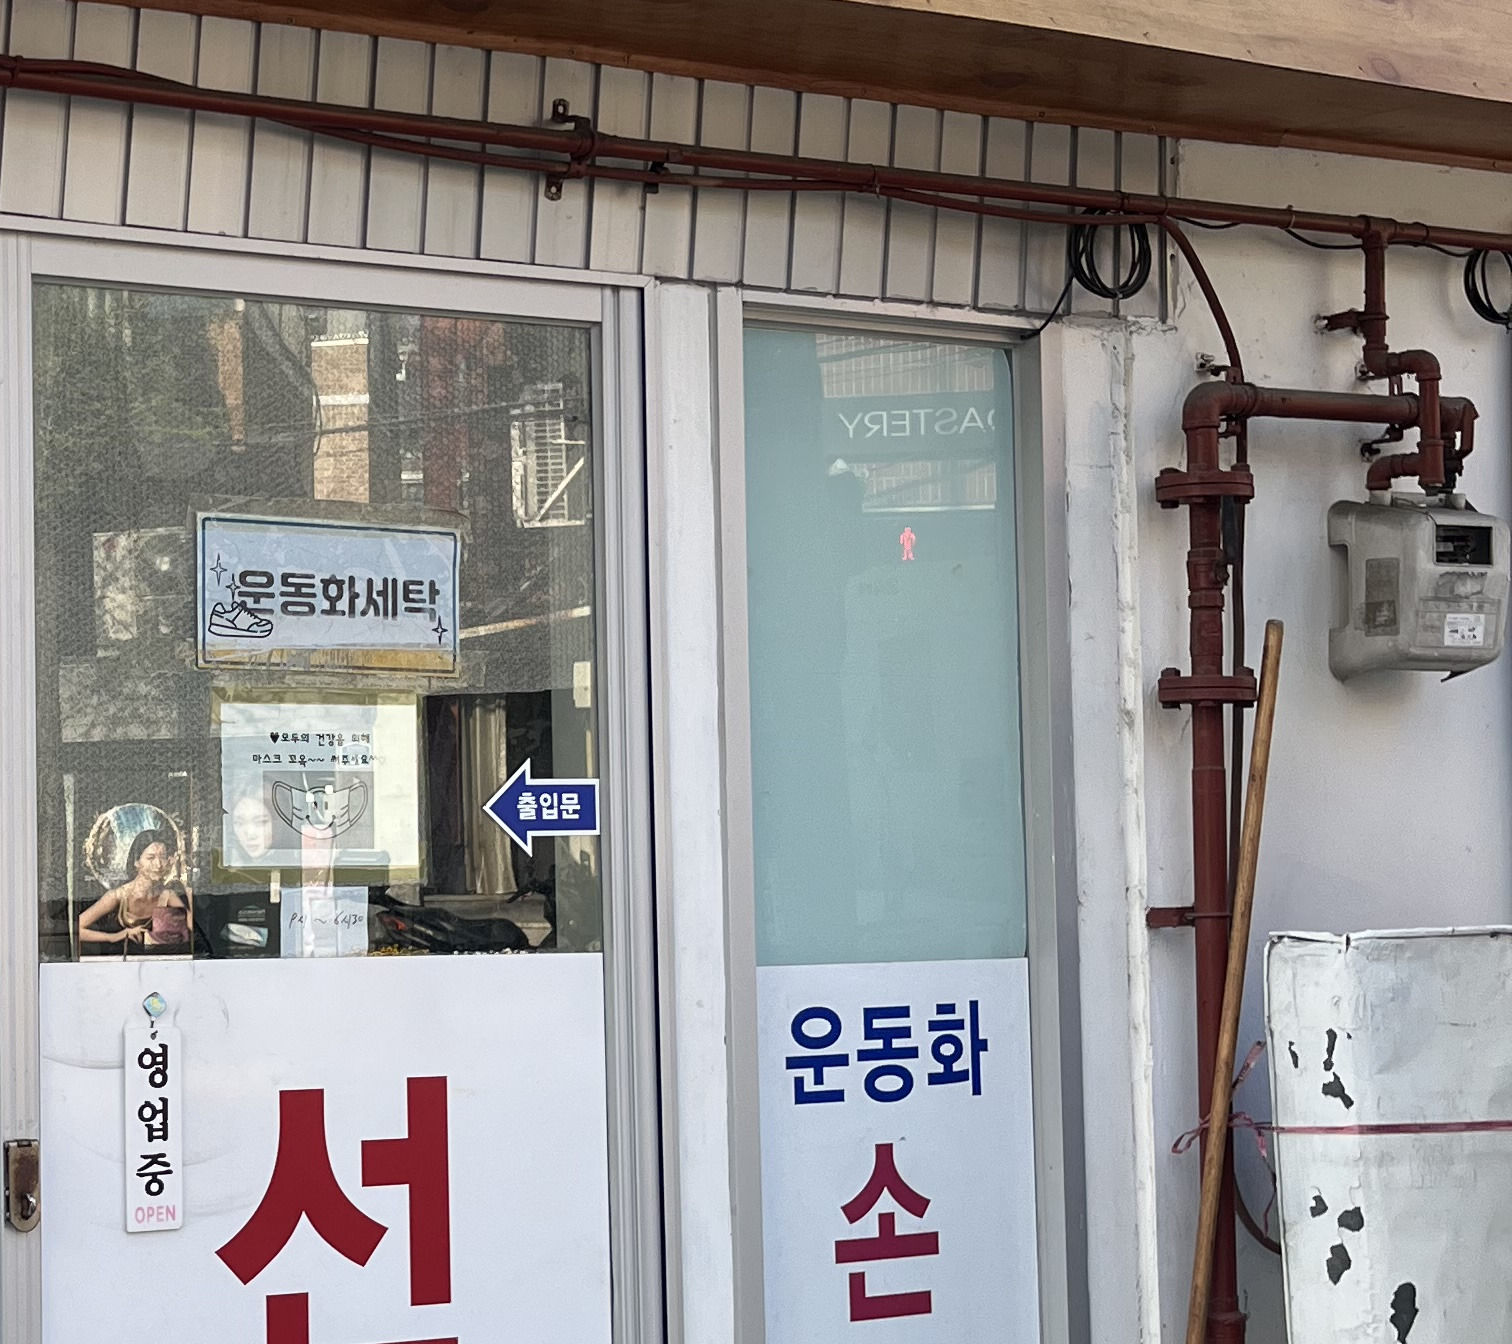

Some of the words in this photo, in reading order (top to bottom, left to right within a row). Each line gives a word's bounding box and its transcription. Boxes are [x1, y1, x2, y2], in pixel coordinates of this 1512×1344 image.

[238, 569, 441, 623] 운동화세탁
[252, 753, 282, 765] 마스크
[314, 732, 345, 747] 건강을
[516, 792, 581, 820] 출입문
[786, 999, 989, 1105] 운동화
[135, 1043, 174, 1197] 영업중
[134, 1204, 177, 1225] OPEN
[833, 1142, 940, 1322] 손
